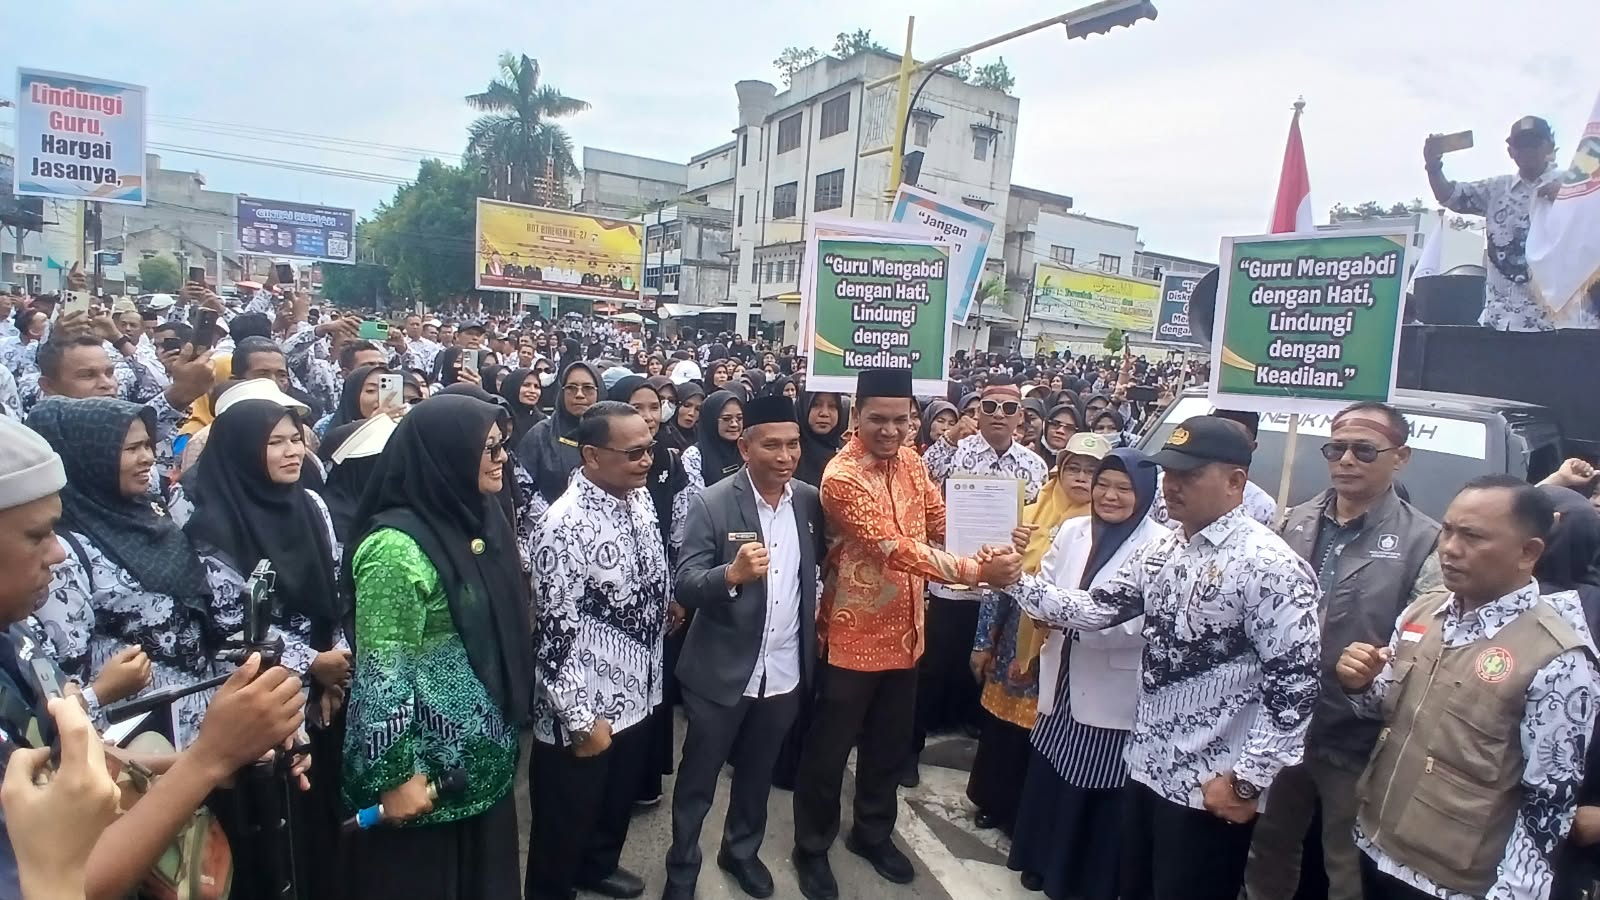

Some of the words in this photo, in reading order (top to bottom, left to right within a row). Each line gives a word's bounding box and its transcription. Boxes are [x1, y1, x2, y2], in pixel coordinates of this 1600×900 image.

[31, 83, 122, 115] Lindungi
[50, 111, 104, 137] Guru,
[41, 134, 112, 160] Hargai
[31, 157, 122, 188] Jasanya,
[825, 255, 868, 275] “Guru
[872, 258, 944, 281] Mengabdi
[1240, 260, 1292, 279] “Guru
[1297, 254, 1396, 281] Mengabdi
[836, 281, 892, 302] dengan
[895, 284, 930, 304] Hati,
[1251, 287, 1321, 308] dengan
[1327, 283, 1374, 307] Hati,
[853, 304, 916, 327] Lindungi
[1269, 312, 1353, 337] Lindungi
[854, 328, 909, 350] dengan
[1269, 339, 1341, 364] dengan
[845, 351, 920, 369] Keadilan.”
[1256, 366, 1355, 388] Keadilan.”
